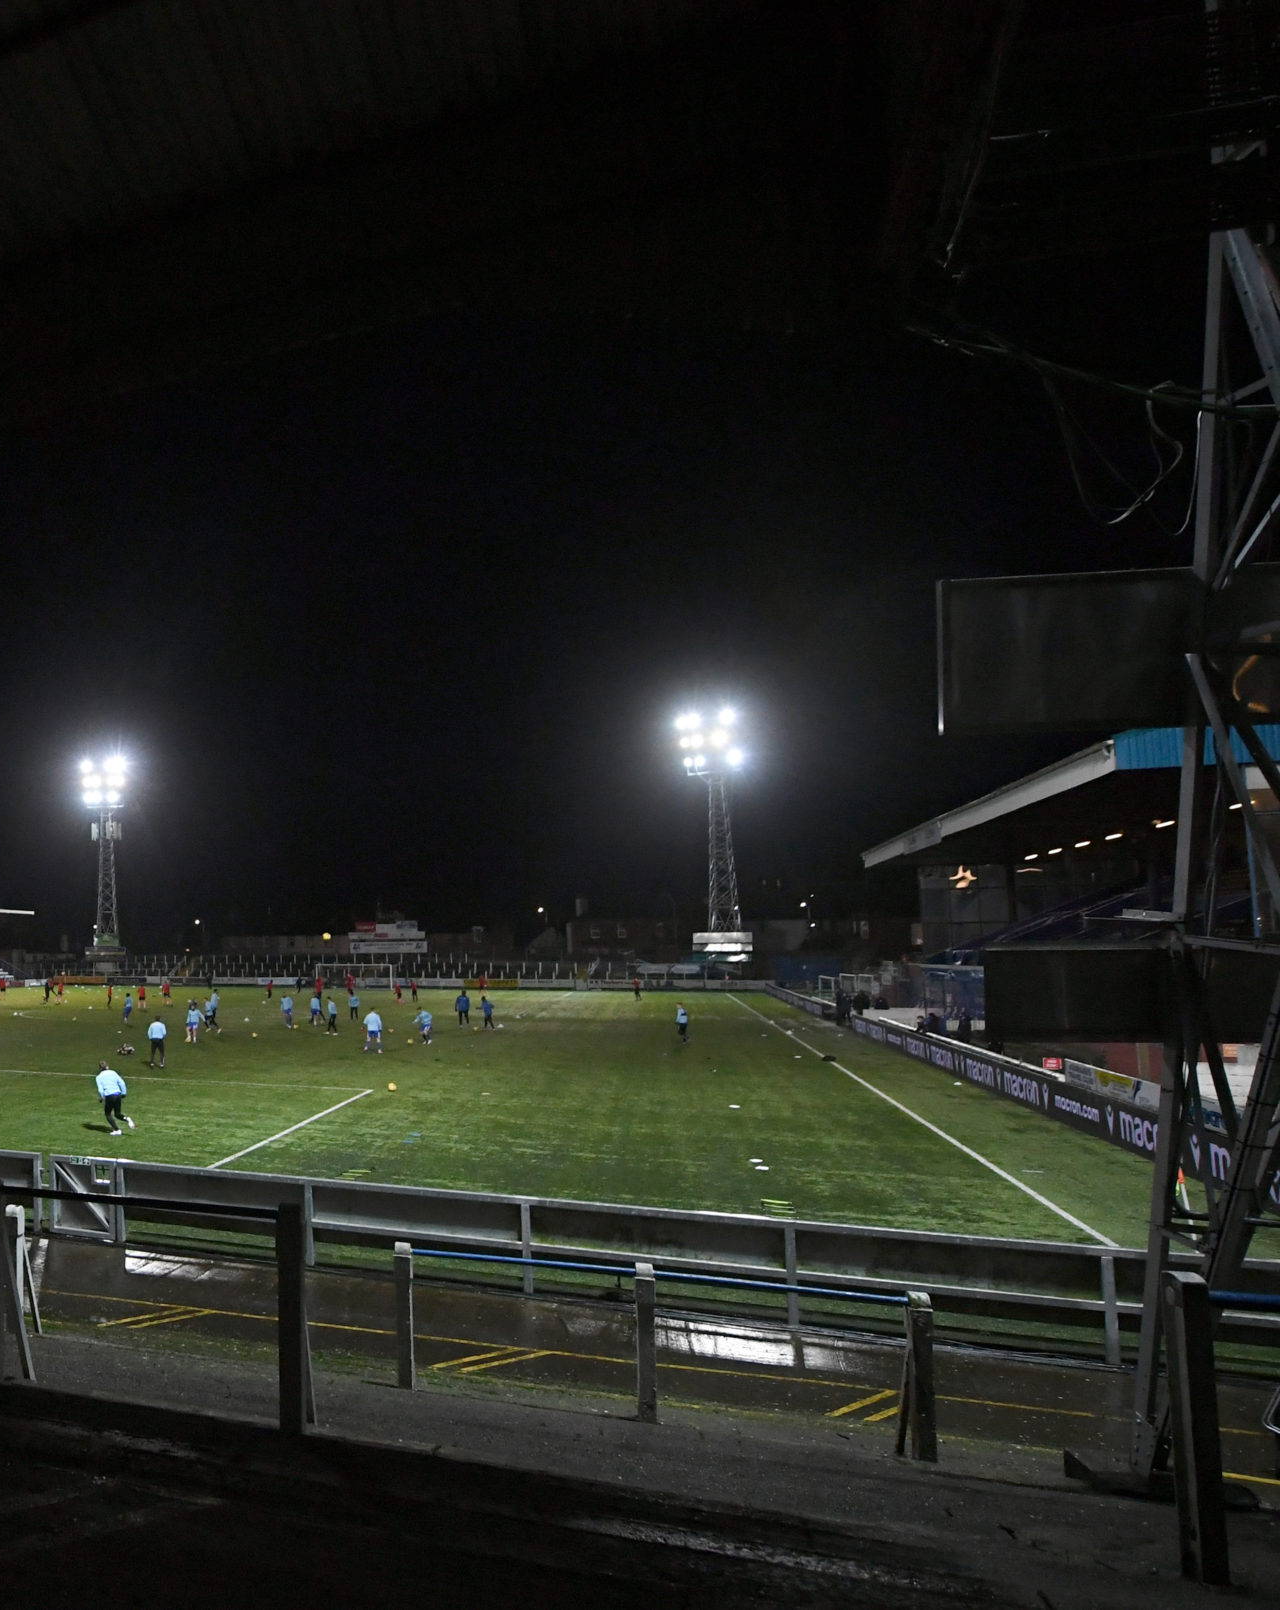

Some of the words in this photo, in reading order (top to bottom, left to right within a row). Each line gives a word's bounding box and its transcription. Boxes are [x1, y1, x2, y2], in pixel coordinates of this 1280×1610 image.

[966, 1058, 995, 1087] macron
[1004, 1071, 1040, 1106] macron
[1055, 1095, 1100, 1122] macron.com
[1120, 1111, 1158, 1152] macr
